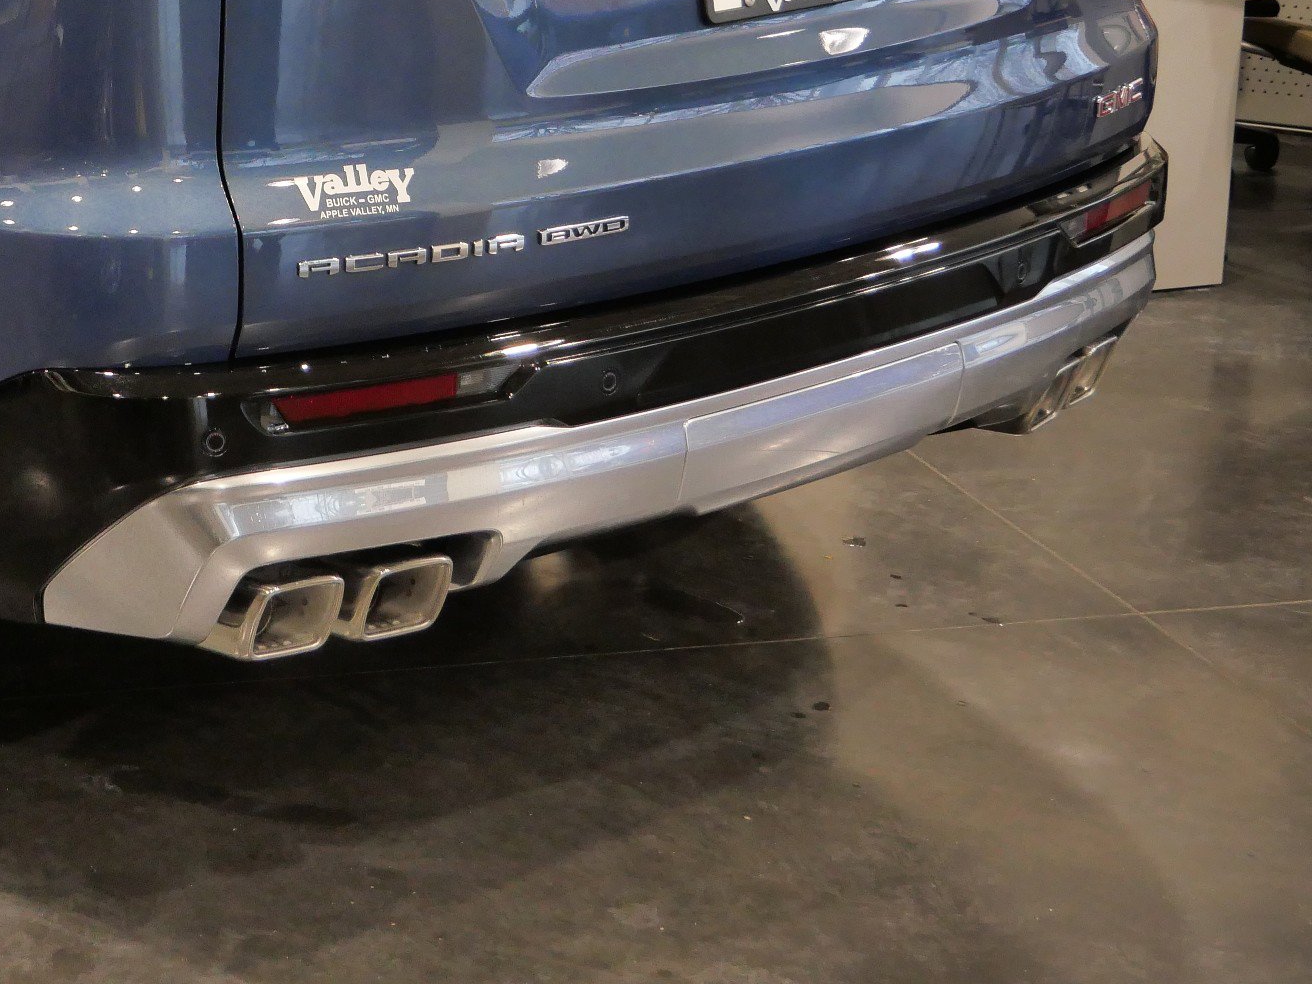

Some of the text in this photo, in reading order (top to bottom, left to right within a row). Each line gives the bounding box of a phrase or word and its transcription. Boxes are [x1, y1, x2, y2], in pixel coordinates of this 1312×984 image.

[1097, 77, 1144, 117] GMC
[320, 208, 348, 219] APPLE
[386, 204, 399, 214] MN
[325, 197, 357, 208] BUICK
[367, 193, 389, 204] GMC
[298, 217, 629, 278] ACADIA AWD
